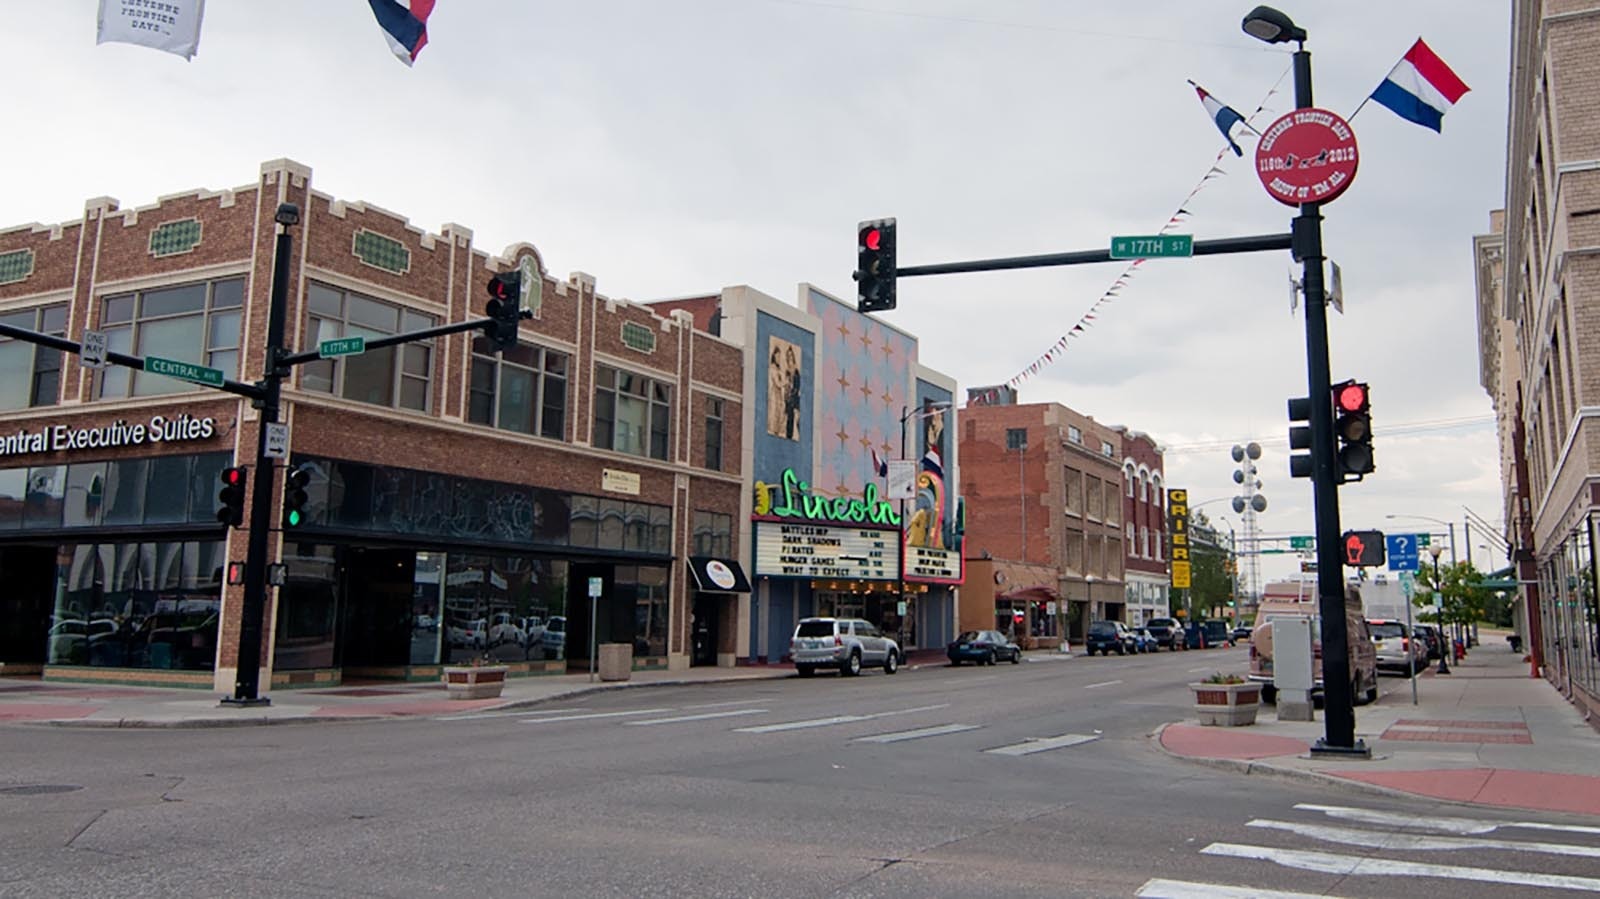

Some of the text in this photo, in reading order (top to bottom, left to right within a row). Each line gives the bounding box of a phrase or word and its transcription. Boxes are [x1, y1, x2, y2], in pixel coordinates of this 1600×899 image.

[121, 7, 176, 25] FRONTIER
[131, 20, 160, 32] DAYS
[1329, 147, 1354, 162] 2012
[1131, 240, 1163, 253] 17TH
[1171, 241, 1184, 251] ST
[87, 333, 104, 344] ONE
[85, 343, 103, 353] WAY
[330, 342, 348, 352] 17TH
[152, 360, 217, 380] CENTRAL AVE
[52, 423, 145, 451] Executive
[149, 413, 214, 442] Suites
[773, 467, 901, 524] Lincoln
[1169, 490, 1188, 559] GRIER
[782, 535, 842, 547] DARK SHADOWS
[781, 546, 815, 555] PIRATES
[780, 556, 836, 566] HUNGER GAMES
[823, 569, 850, 577] EXPECT
